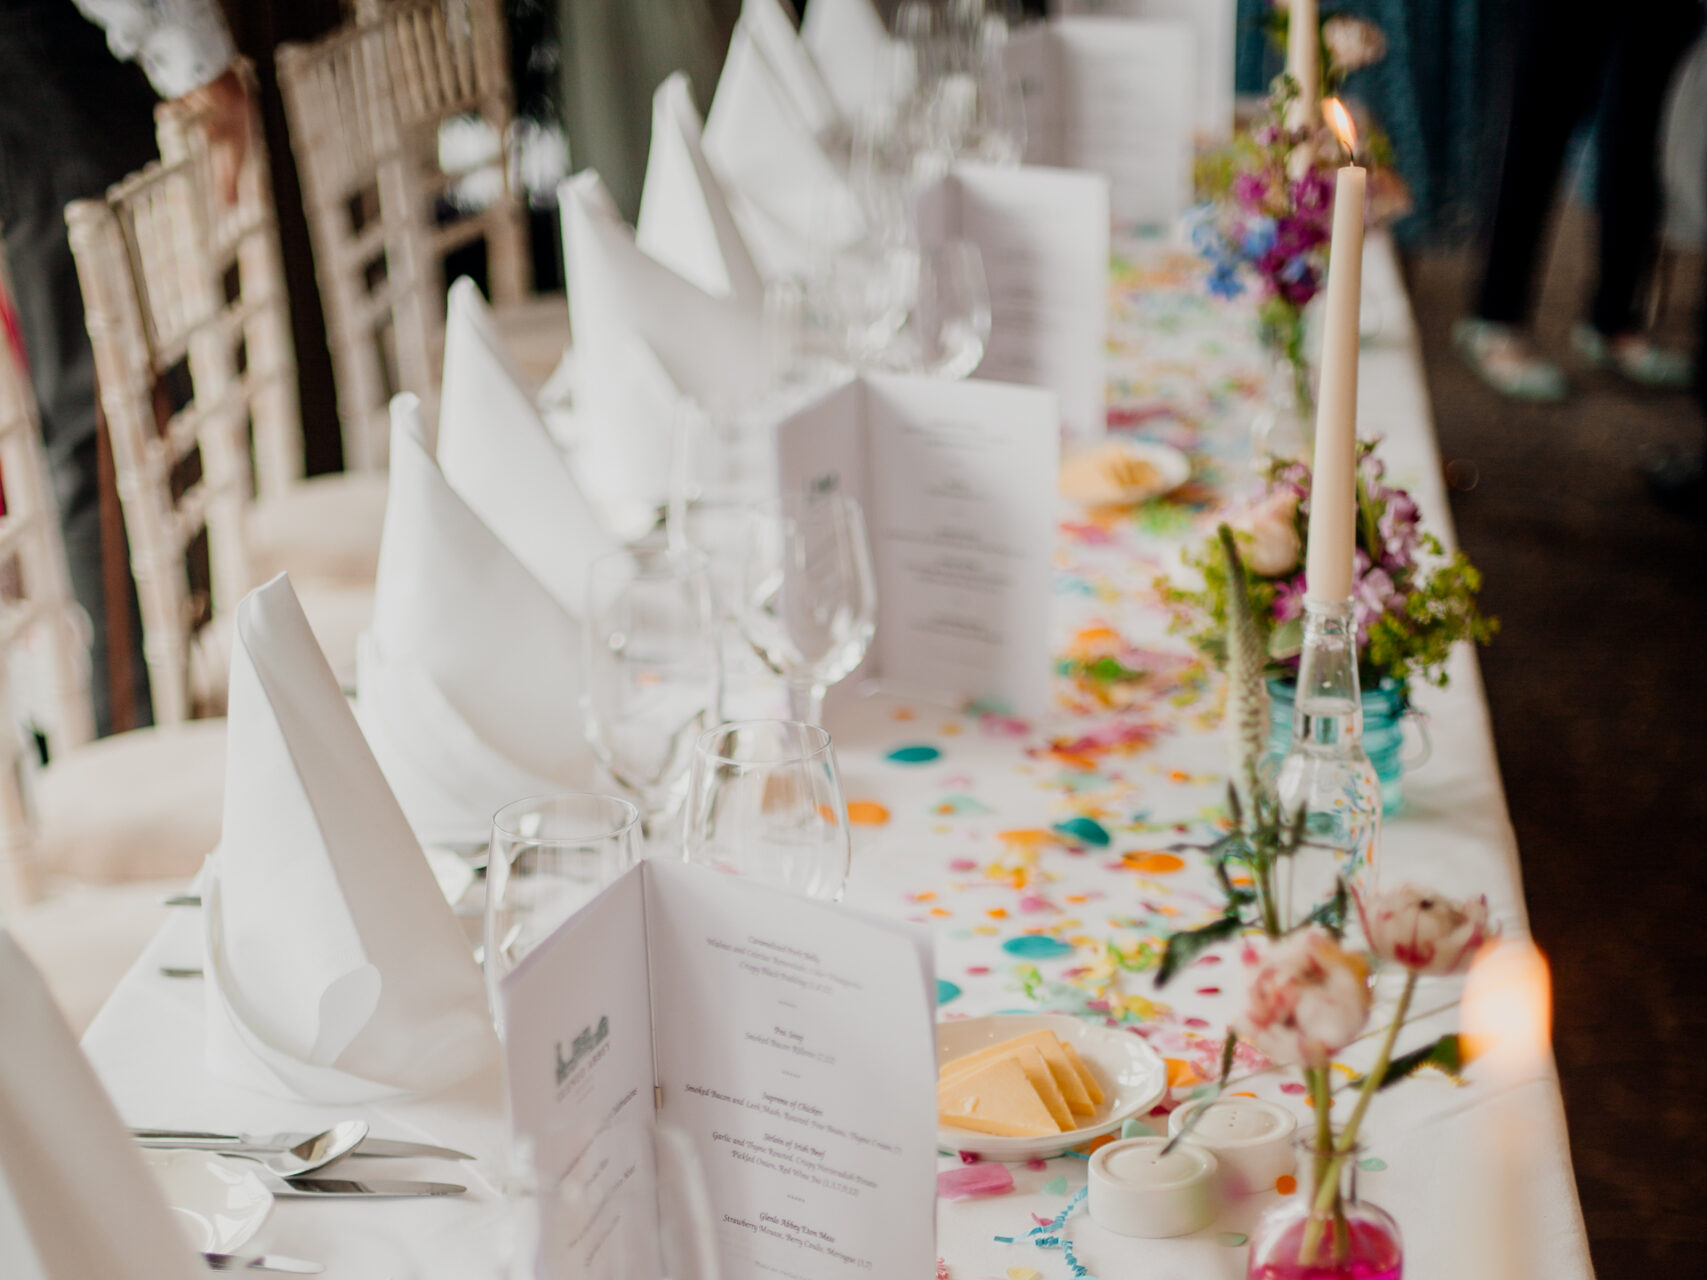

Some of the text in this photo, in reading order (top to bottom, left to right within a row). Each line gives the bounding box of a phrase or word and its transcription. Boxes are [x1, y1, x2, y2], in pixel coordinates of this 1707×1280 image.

[684, 1083, 710, 1097] Smoked
[710, 1089, 732, 1102] Bacon
[732, 1097, 746, 1107] and
[712, 1130, 732, 1143] Garlic
[732, 1138, 746, 1148] and
[731, 1149, 756, 1164] Pickled
[722, 1213, 758, 1234] Strawberry
[785, 1233, 803, 1249] Berry
[780, 1218, 801, 1235] Abbey
